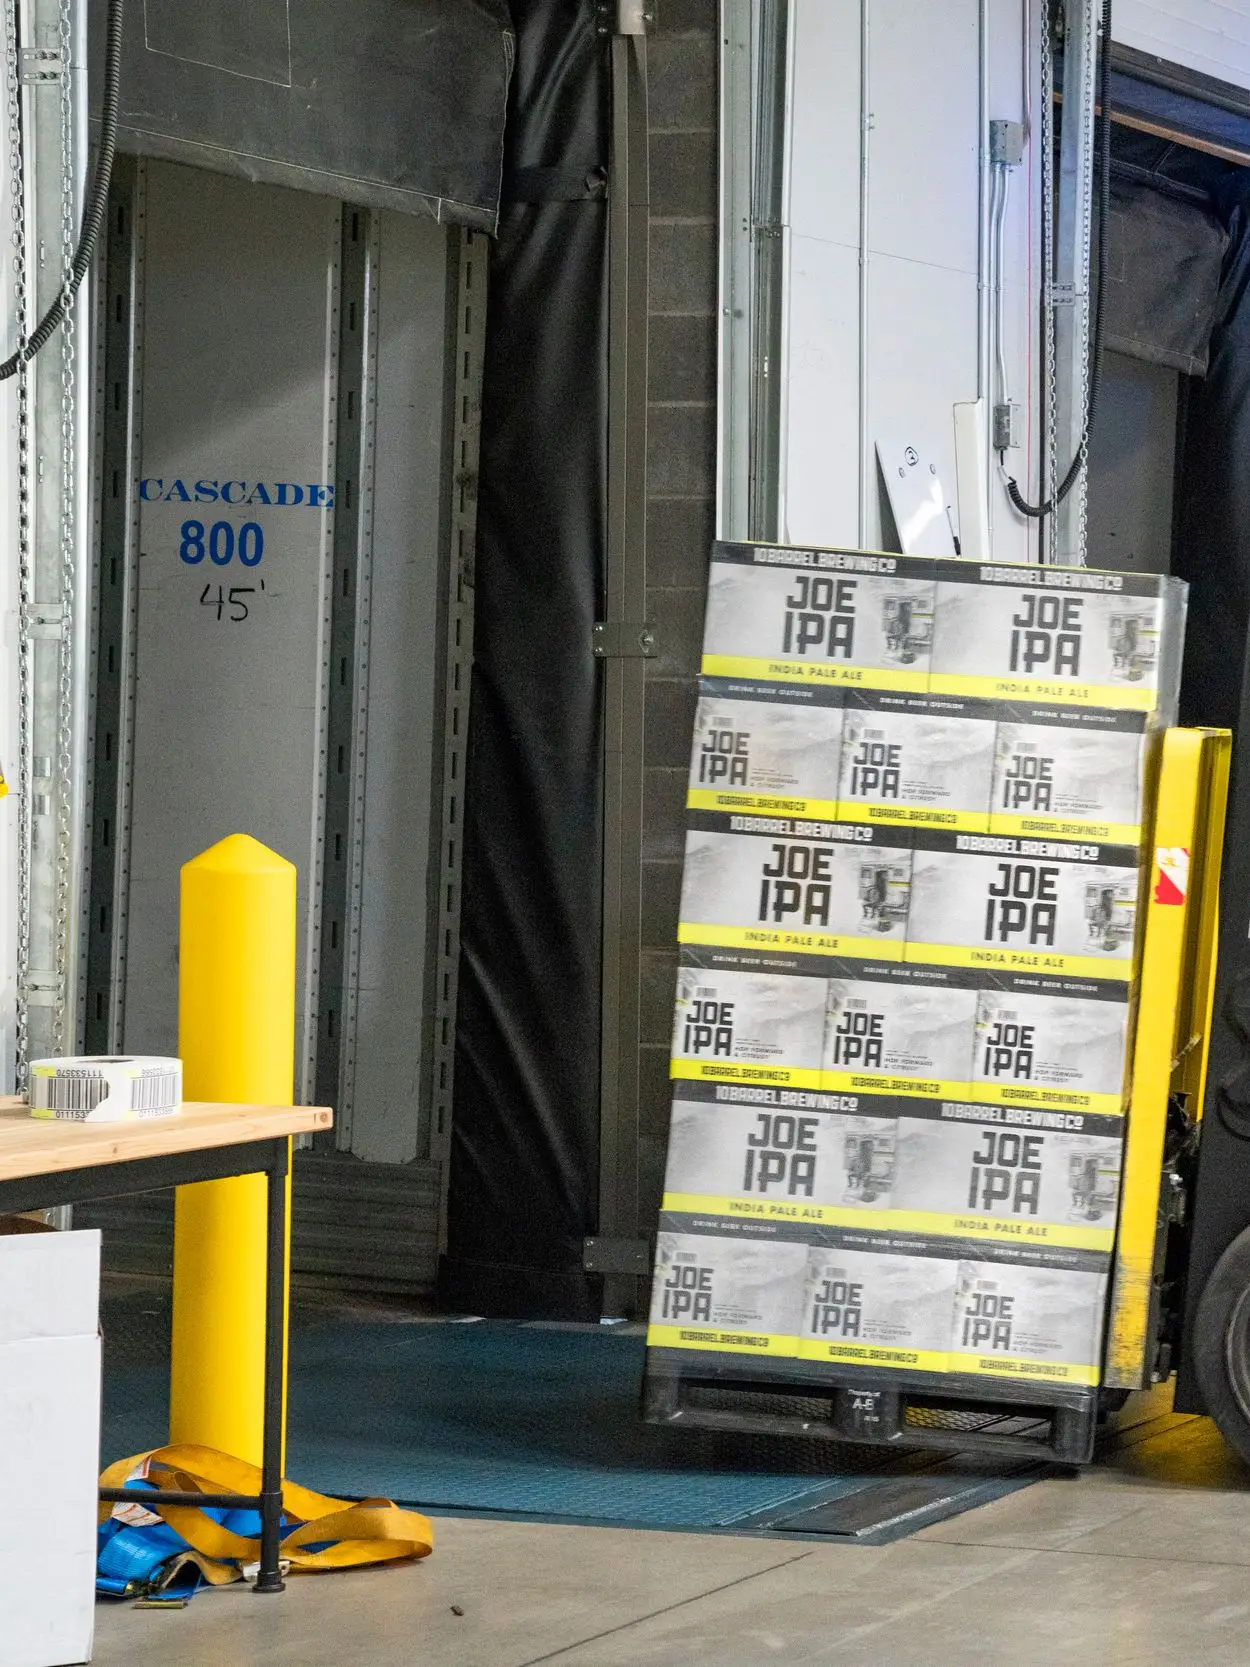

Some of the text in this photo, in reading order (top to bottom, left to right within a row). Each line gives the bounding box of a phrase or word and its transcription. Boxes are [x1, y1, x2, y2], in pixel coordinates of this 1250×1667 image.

[139, 478, 334, 507] CASCADE
[179, 519, 264, 567] 800
[787, 576, 857, 614] JOE
[1013, 594, 1084, 632] JOE
[782, 611, 856, 659] IPA
[1008, 629, 1082, 677] IPA
[769, 664, 862, 680] INDIA PALE ALE
[996, 682, 1089, 698] INDIA PALE ALE
[702, 730, 750, 756] JOE
[853, 742, 901, 768] JOE
[699, 754, 748, 786] IPA
[851, 766, 899, 798] IPA
[1006, 755, 1053, 781] JOE
[1003, 779, 1051, 811] IPA
[763, 844, 834, 882] JOE
[989, 863, 1060, 901] JOE
[758, 879, 832, 927] IPA
[984, 898, 1058, 946] IPA
[745, 932, 838, 948] INDIA PALE ALE
[971, 951, 1064, 967] INDIA PALE ALE
[686, 1000, 734, 1026] JOE
[836, 1011, 884, 1038] JOE
[683, 1024, 732, 1056] IPA
[833, 1035, 882, 1068] IPA
[987, 1022, 1034, 1050] JOE
[983, 1047, 1032, 1080] IPA
[748, 1113, 819, 1152] JOE
[973, 1131, 1044, 1170] JOE
[743, 1148, 817, 1196] IPA
[968, 1167, 1041, 1216] IPA
[730, 1201, 823, 1217] INDIA PALE ALE
[954, 1220, 1047, 1237] INDIA PALE ALE
[665, 1265, 713, 1292] JOE
[815, 1280, 863, 1307] JOE
[662, 1289, 711, 1322] IPA
[811, 1304, 860, 1337] IPA
[966, 1293, 1013, 1320] JOE
[963, 1317, 1010, 1350] IPA
